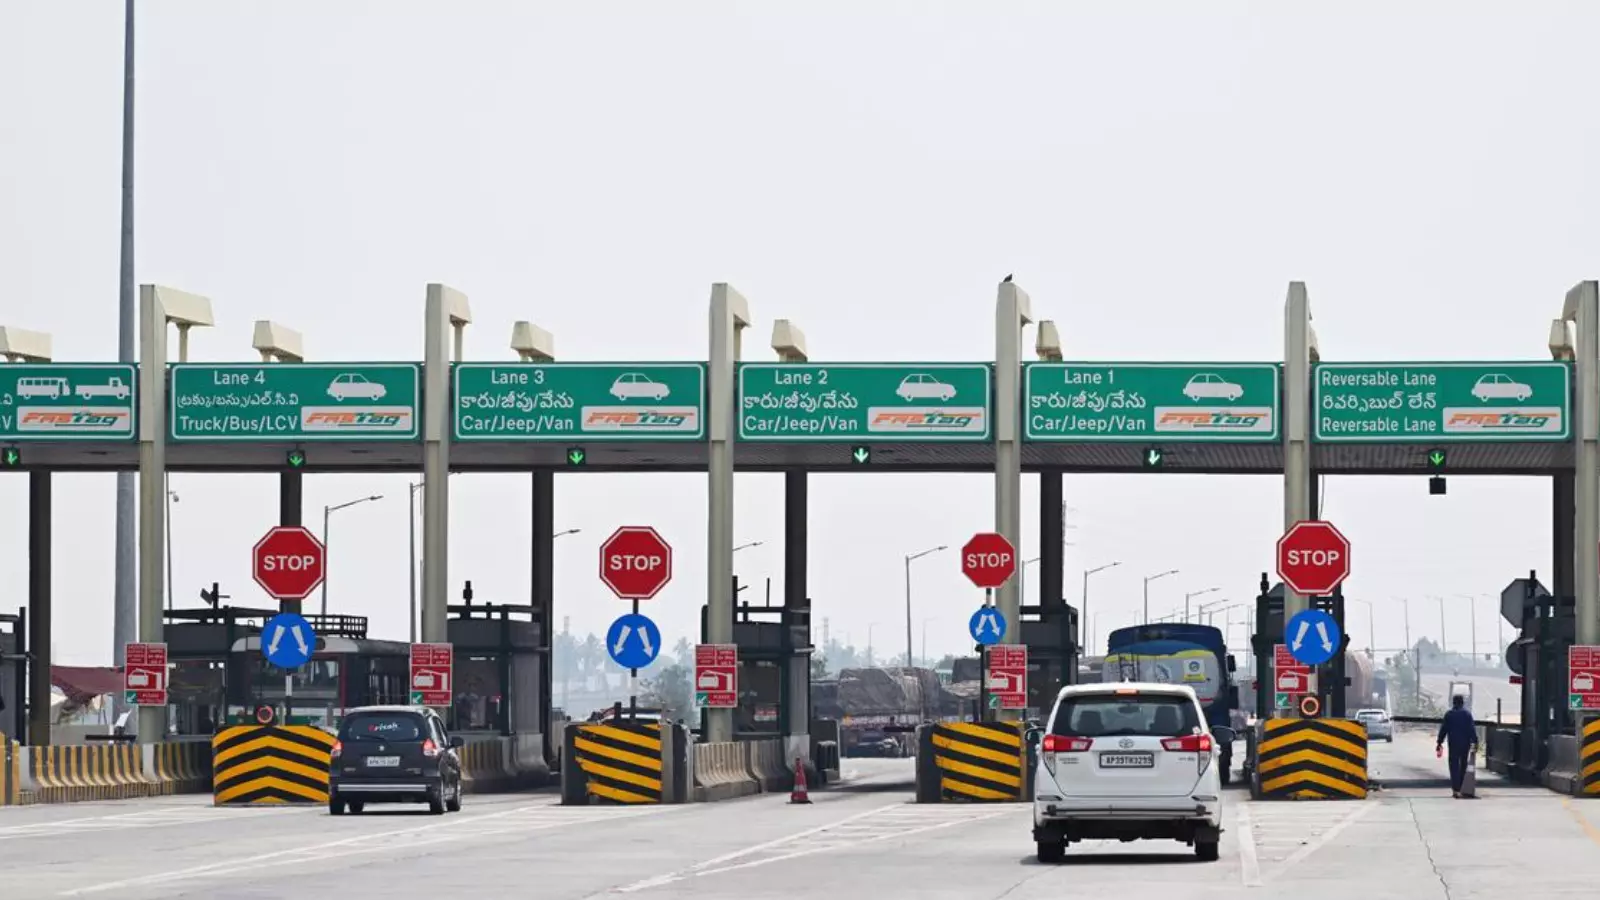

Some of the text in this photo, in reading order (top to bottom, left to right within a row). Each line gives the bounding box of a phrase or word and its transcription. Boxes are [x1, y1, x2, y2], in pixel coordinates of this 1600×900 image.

[213, 370, 266, 385] Lane 4
[491, 369, 545, 385] Lane 3
[774, 369, 828, 385] Lane 2
[1064, 369, 1114, 385] Lane 1
[1321, 370, 1437, 386] Reversable Lane
[179, 415, 298, 432] Truck/Bus/LCV
[461, 415, 574, 432] Car/Jeep/Van
[744, 415, 857, 432] Car/Jeep/Van
[1032, 415, 1147, 432] Car/Jeep/Van
[1321, 416, 1437, 432] Reversable Lane
[263, 555, 315, 571] STOP
[610, 555, 662, 571] STOP
[967, 553, 1011, 569] STOP
[1287, 549, 1340, 566] STOP
